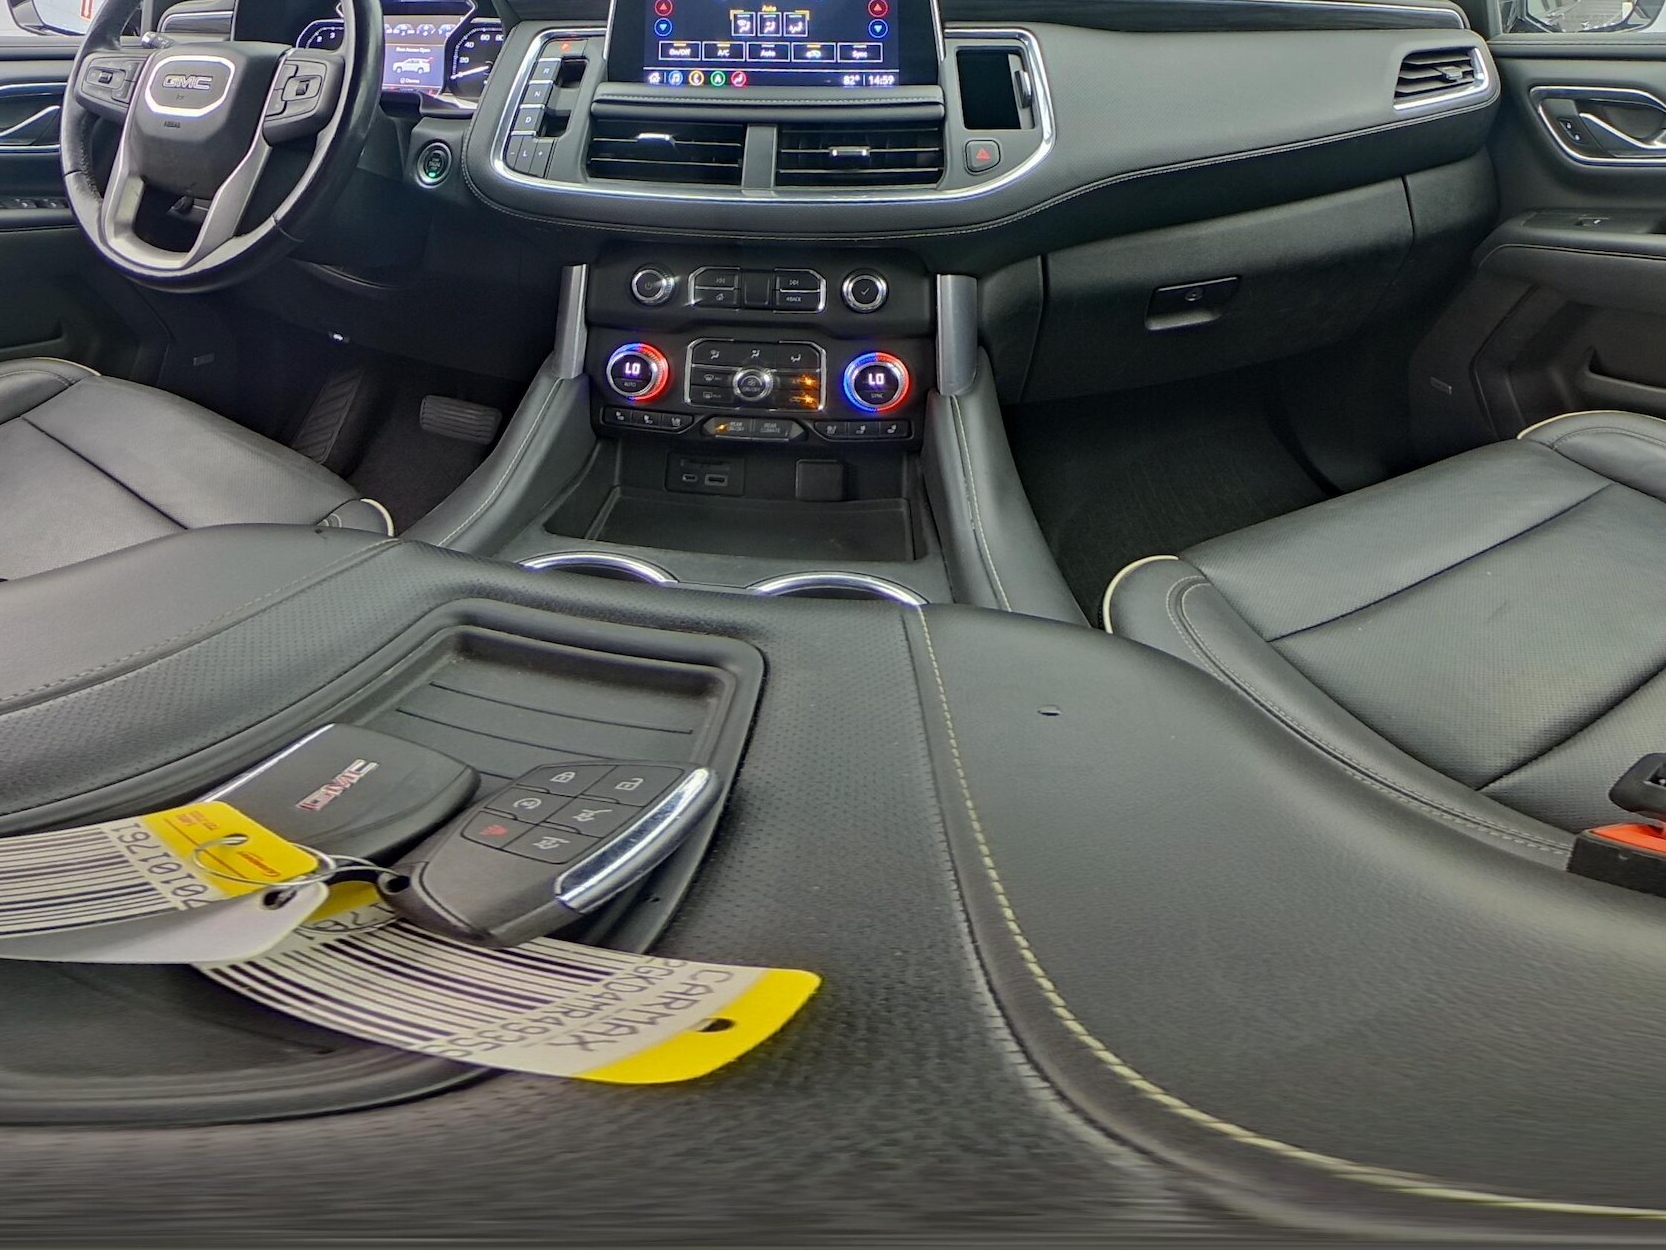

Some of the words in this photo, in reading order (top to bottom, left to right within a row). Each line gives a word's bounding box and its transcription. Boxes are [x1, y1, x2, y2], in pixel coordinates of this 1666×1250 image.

[464, 41, 474, 49] 40
[163, 75, 213, 90] GMC
[869, 75, 894, 86] 14:59
[625, 362, 641, 375] LO
[869, 373, 885, 386] LO
[549, 968, 734, 1052] CARMAX
